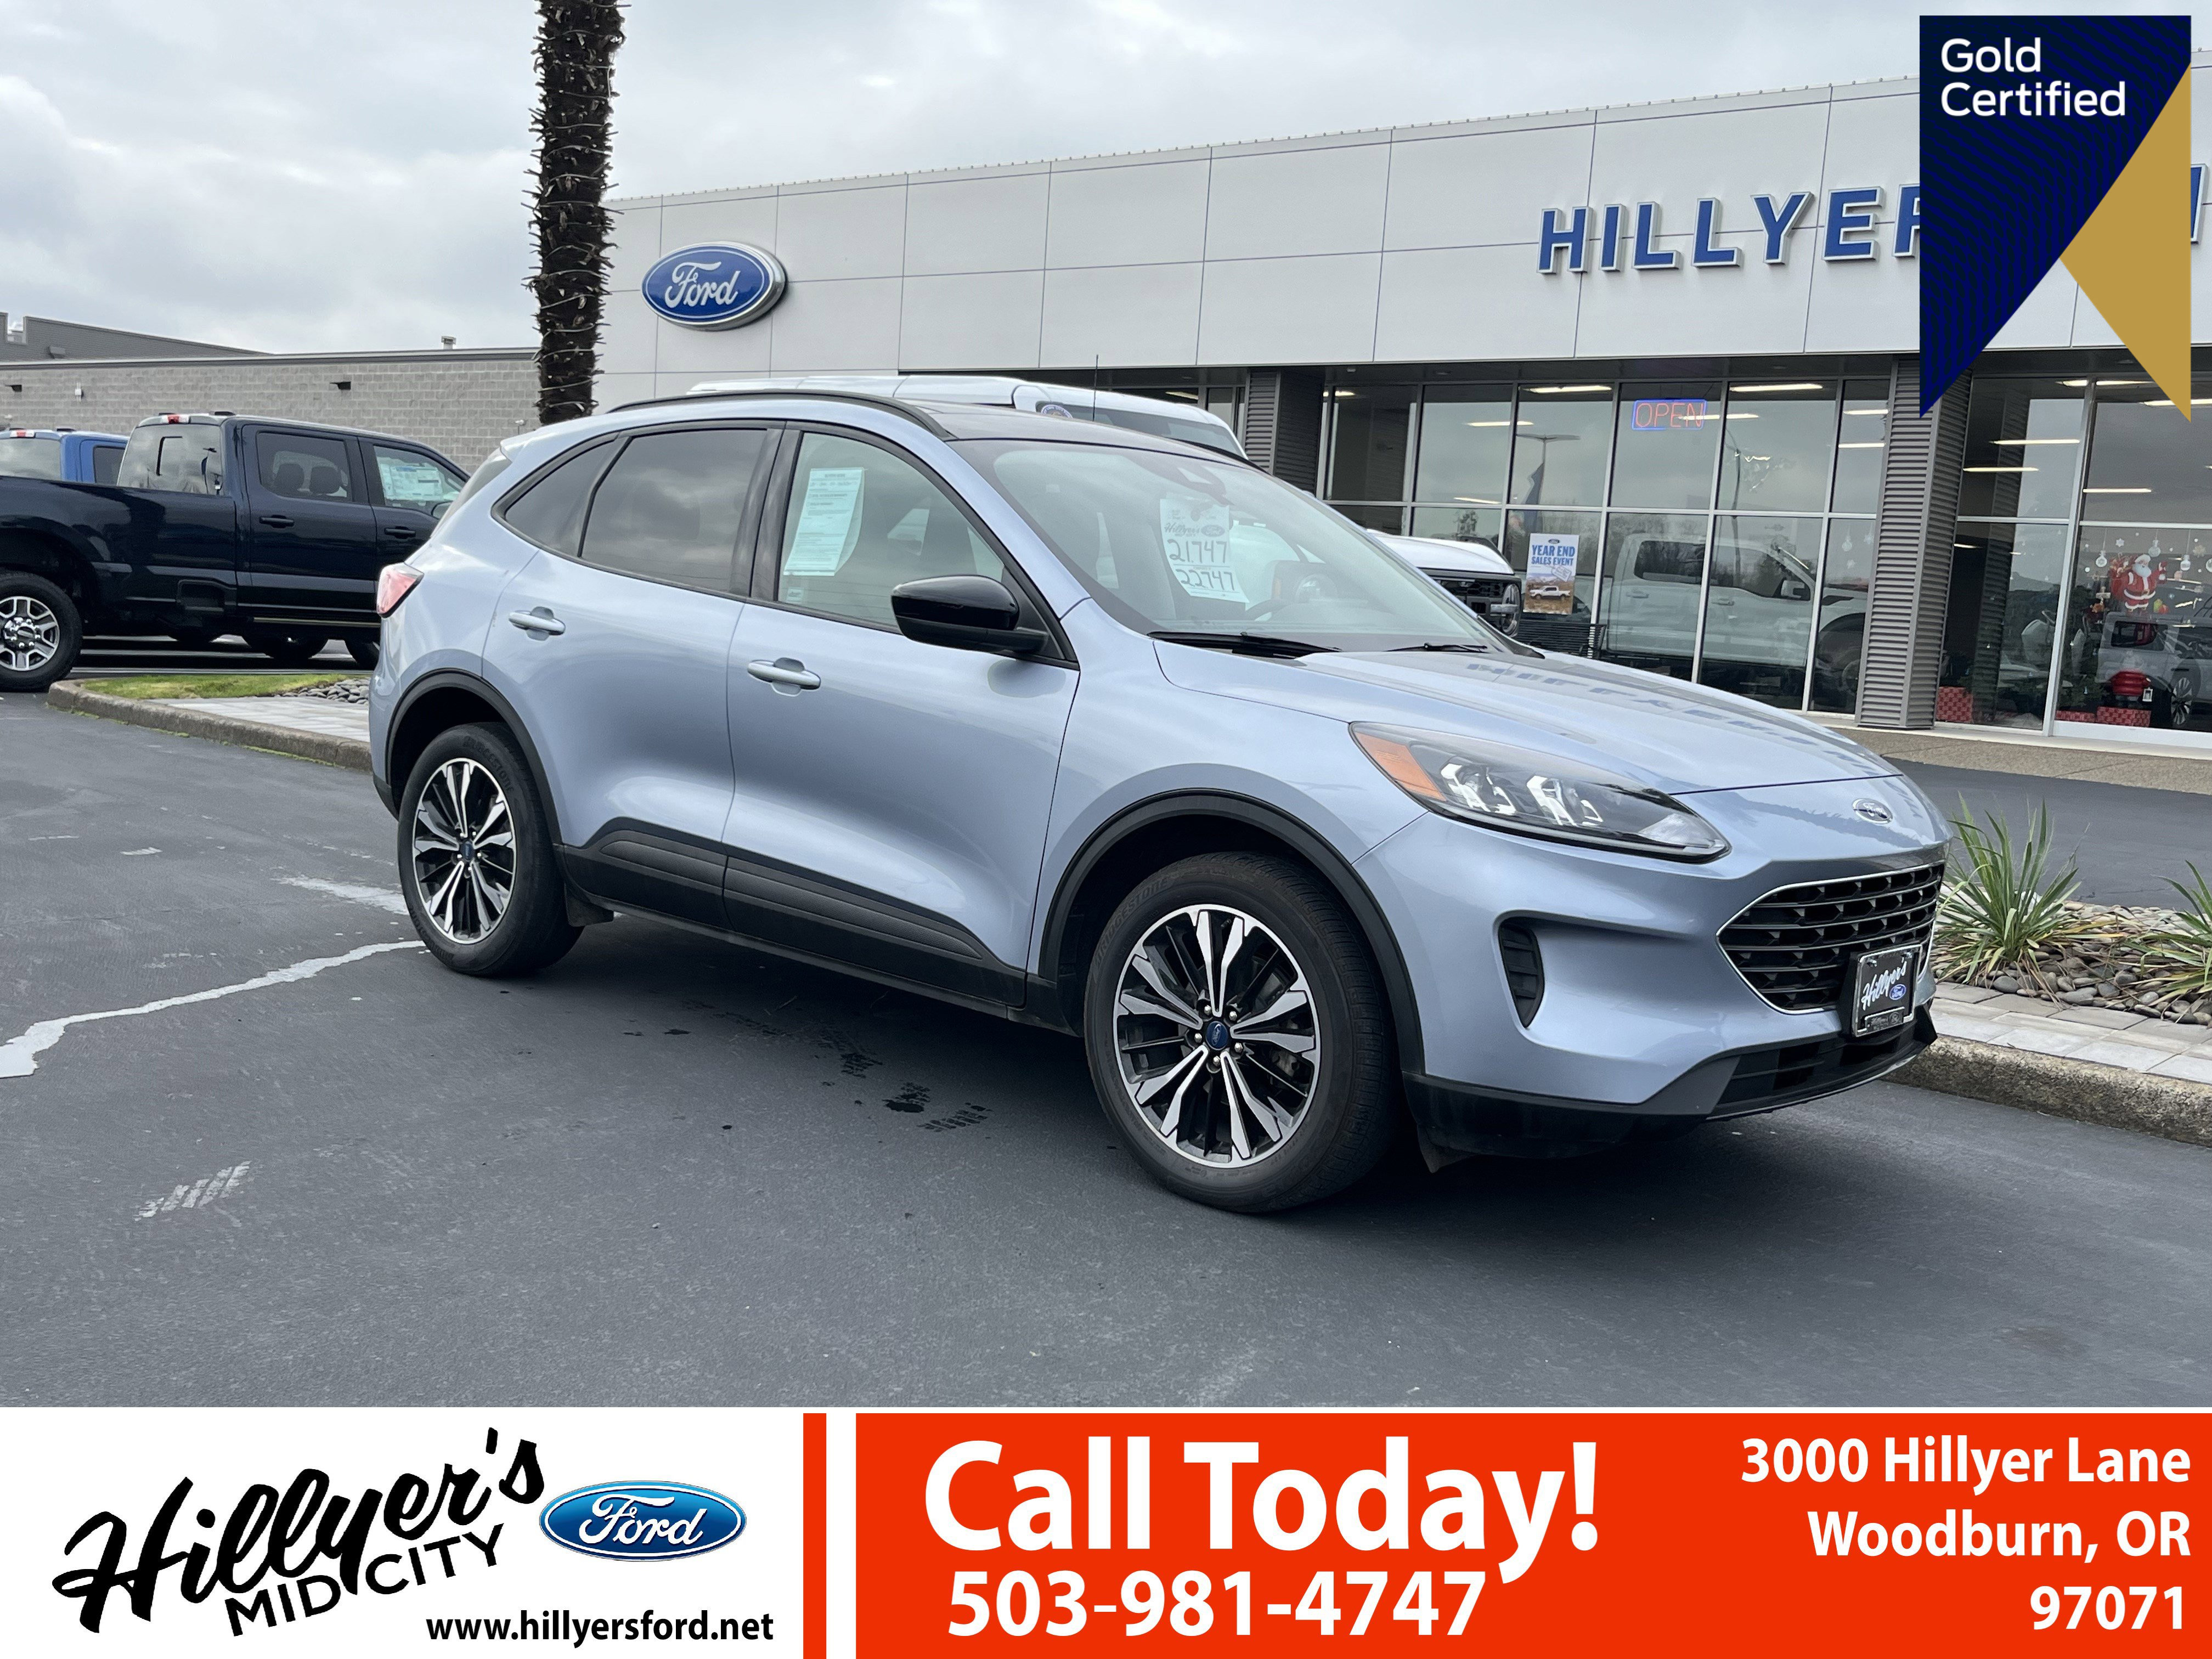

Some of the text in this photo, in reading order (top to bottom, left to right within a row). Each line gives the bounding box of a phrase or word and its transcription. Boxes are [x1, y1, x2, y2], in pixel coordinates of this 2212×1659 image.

[664, 261, 741, 308] Ford
[1635, 402, 1704, 428] OPEN
[1532, 544, 1576, 557] YEAR END
[1531, 556, 1574, 566] SALES EVENT
